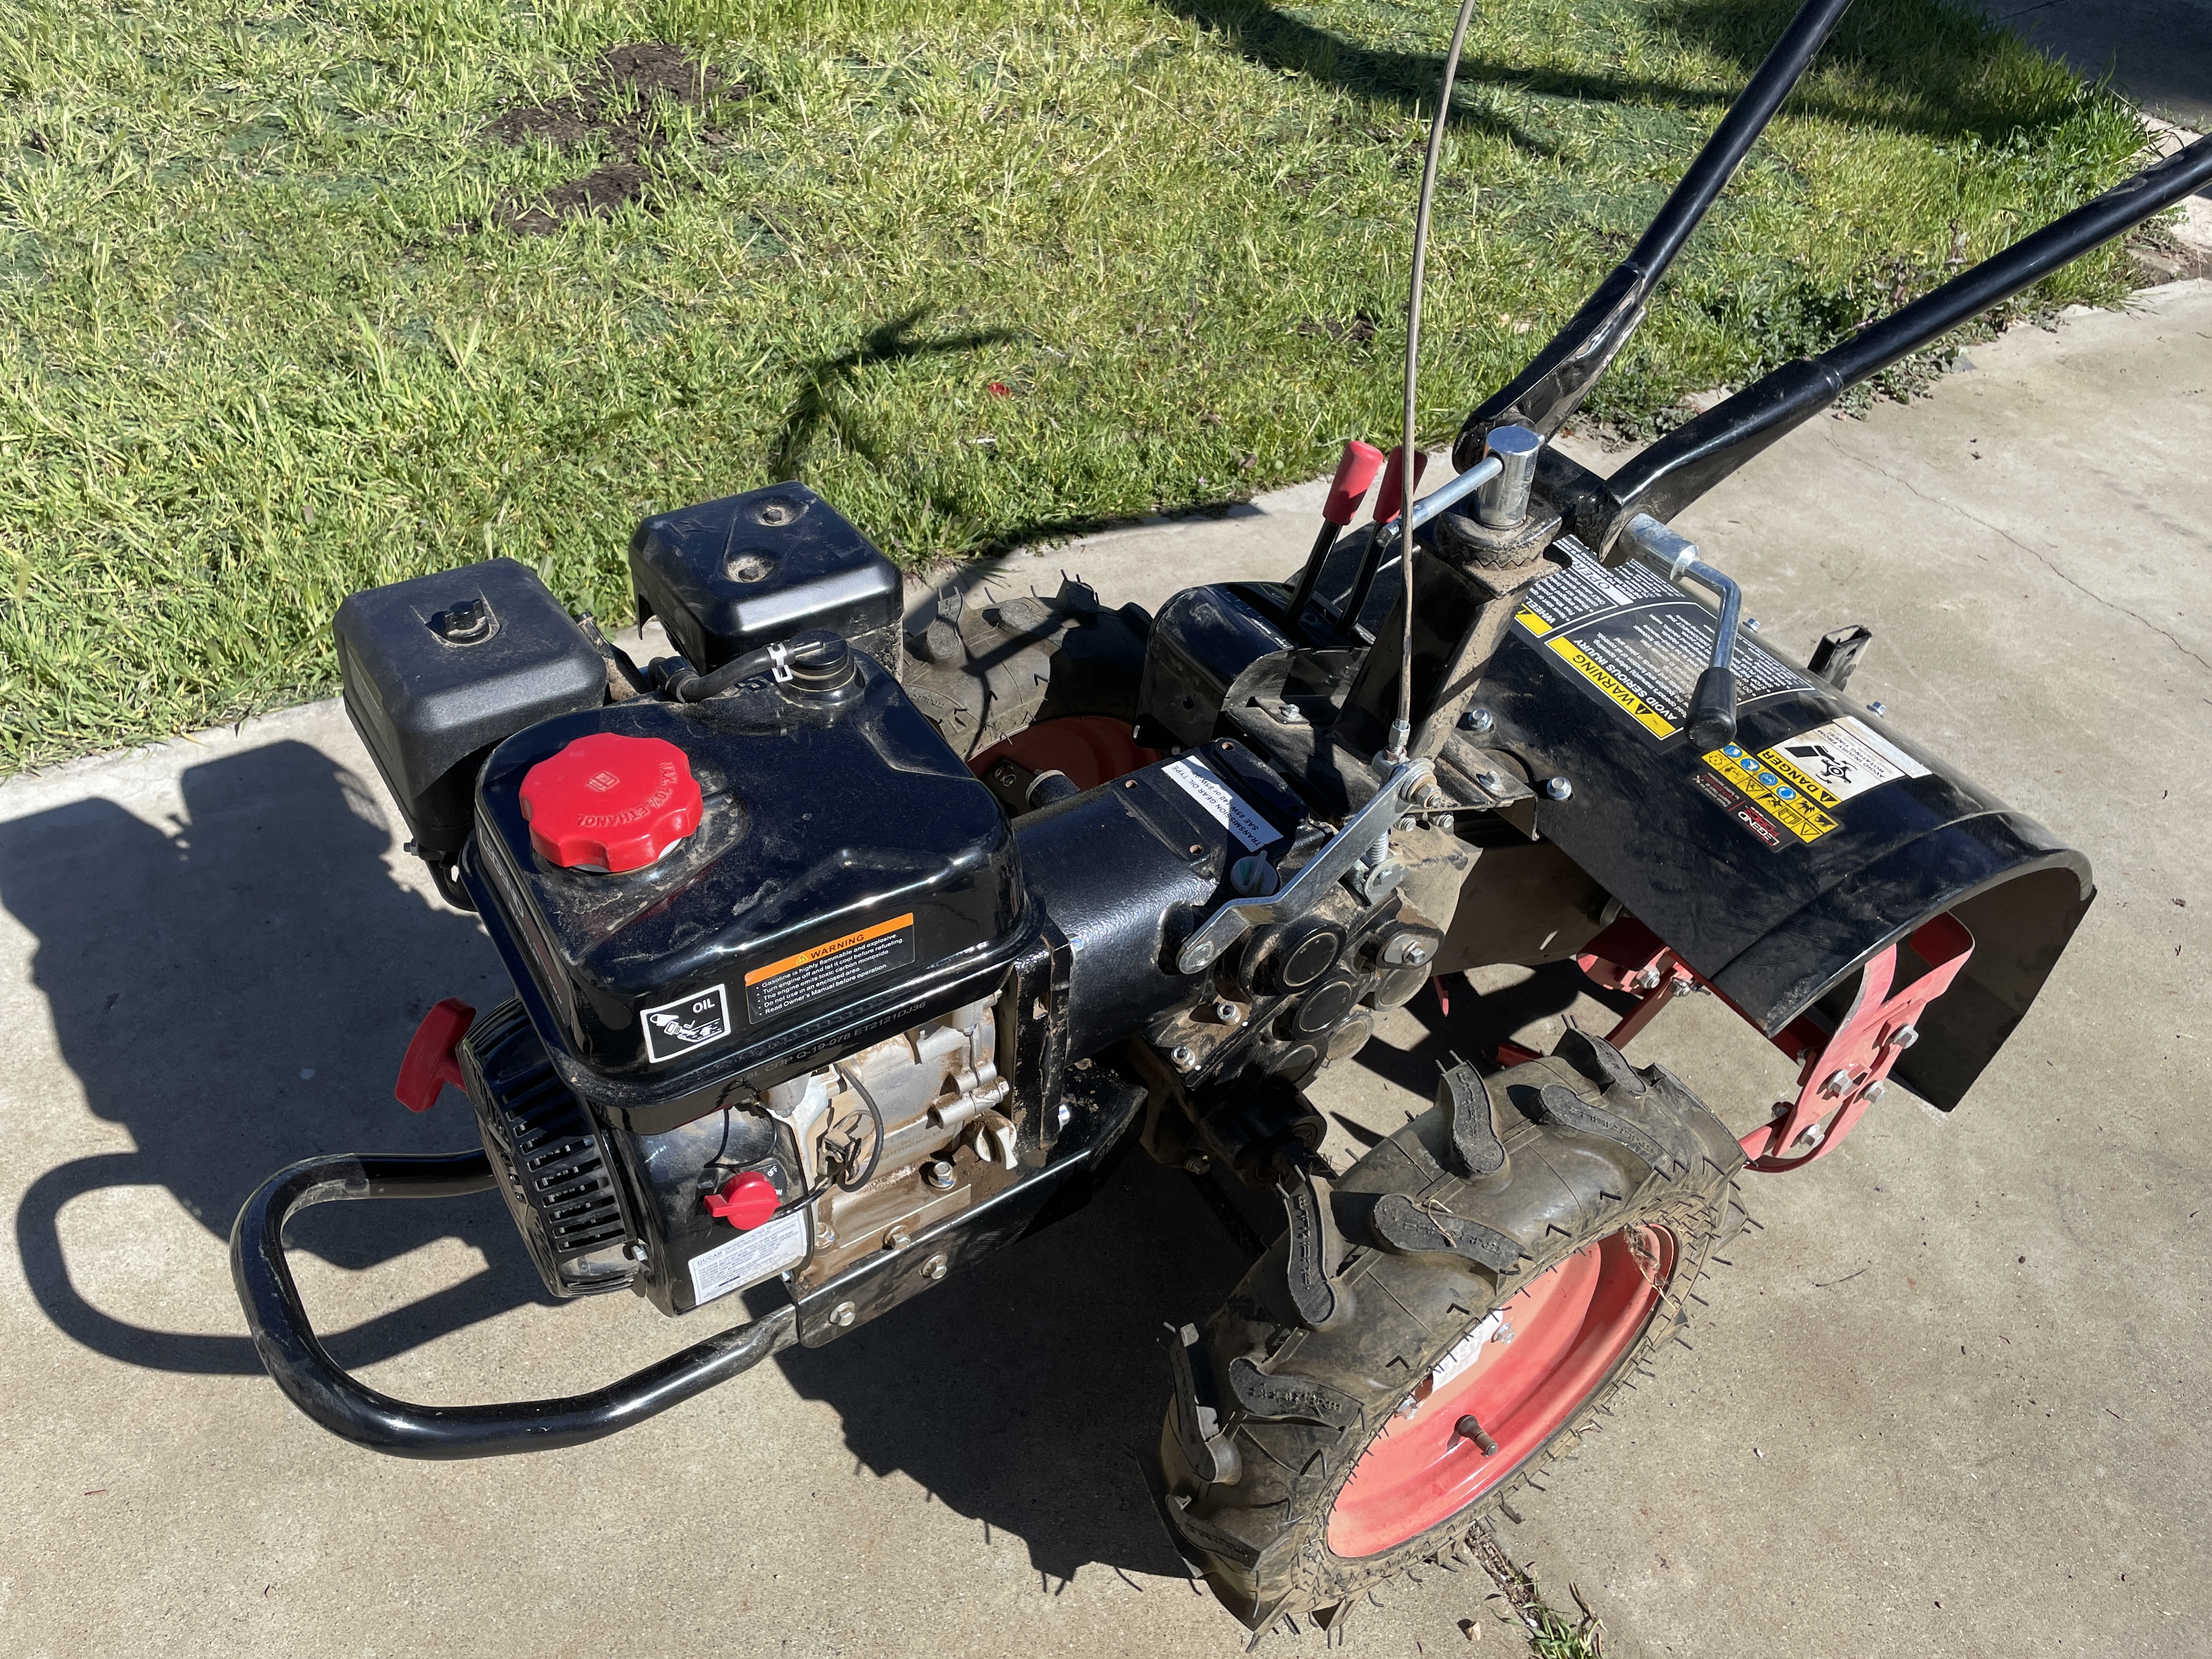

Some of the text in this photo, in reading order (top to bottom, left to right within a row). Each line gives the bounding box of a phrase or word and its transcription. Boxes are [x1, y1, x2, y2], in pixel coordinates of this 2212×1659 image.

[1590, 593, 1606, 605] ONLY
[1572, 637, 1609, 665] INJURY
[1570, 653, 1637, 706] WARNING
[1603, 663, 1649, 698] SERIOUS
[1644, 696, 1678, 721] AVOID
[1816, 729, 1838, 744] FROM
[1837, 744, 1863, 762] INJURY
[1849, 747, 1885, 773] ROTATING
[1759, 751, 1820, 792] DANGER
[1862, 763, 1884, 778] AVOID
[647, 788, 673, 808] 10%
[1171, 765, 1262, 846] TRANSMISSION GEAR OIL TYPE
[1218, 795, 1246, 819] 85W-140
[577, 806, 650, 827] ETHANOL
[1243, 818, 1259, 831] SAE
[1736, 809, 1780, 846] LEGEND
[476, 825, 526, 921] LEGEND
[761, 972, 791, 988] Gasoline
[799, 962, 818, 974] highly
[819, 949, 852, 966] flammable
[853, 944, 865, 952] and
[866, 932, 898, 949] explosive.
[811, 933, 864, 959] WARNING
[763, 984, 778, 994] Turn
[778, 975, 801, 989] engine
[802, 971, 810, 979] off
[811, 967, 823, 975] and
[825, 962, 833, 970] let
[839, 955, 853, 964] cool
[854, 947, 873, 959] before
[875, 936, 904, 952] refueling.
[764, 948, 890, 1001] The engine emits toxic carbon monoxide.
[764, 999, 774, 1007] Do
[786, 990, 798, 998] use
[816, 972, 844, 987] enclosed
[845, 966, 861, 976] area.
[765, 962, 888, 1014] Read Owner's Manual before operation.
[692, 998, 715, 1013] OIL
[735, 1001, 926, 1084] 3.6L CDP Q-19-078 ET2121DJ36
[767, 1165, 778, 1177] OFF
[697, 1250, 723, 1266] DUCAR
[724, 1238, 746, 1251] EMISSION
[746, 1228, 765, 1240] CONTROL
[766, 1214, 795, 1229] INFORMATION
